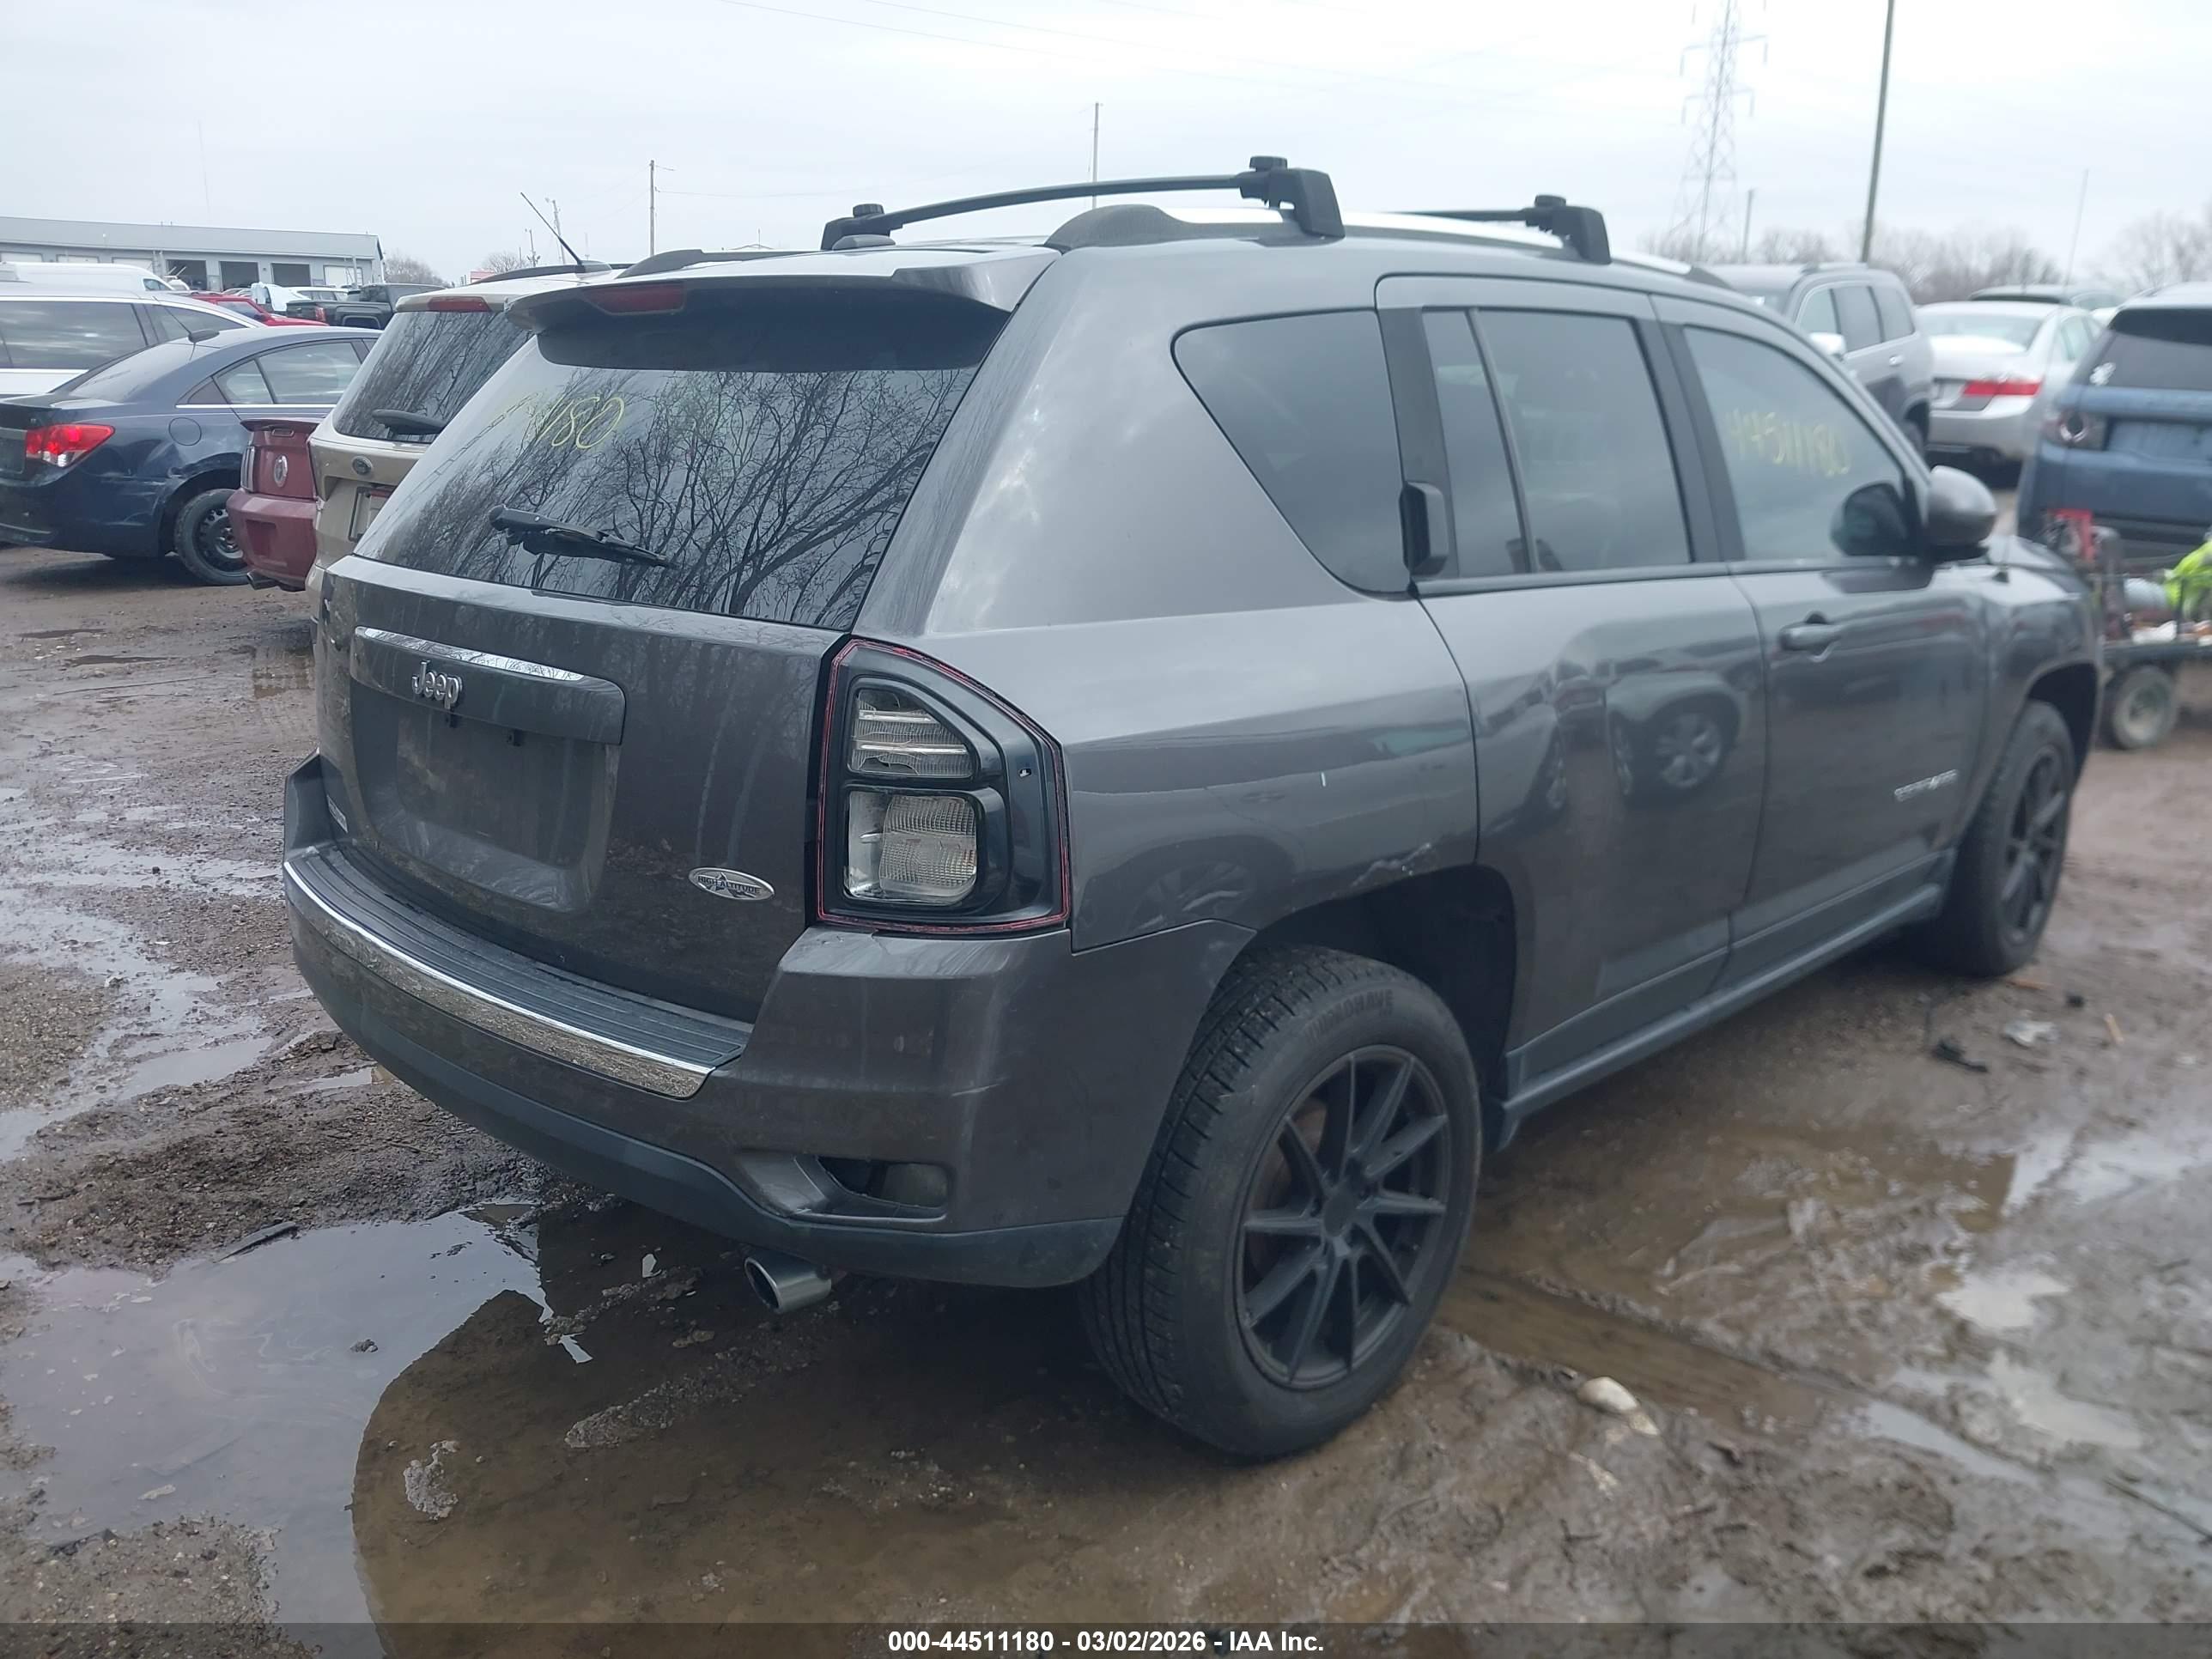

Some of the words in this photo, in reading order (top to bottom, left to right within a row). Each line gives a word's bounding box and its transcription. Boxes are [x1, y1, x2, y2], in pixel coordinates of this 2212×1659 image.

[412, 659, 461, 709] Jeep
[697, 875, 718, 888] HIGH
[719, 878, 761, 895] ALTITUDE
